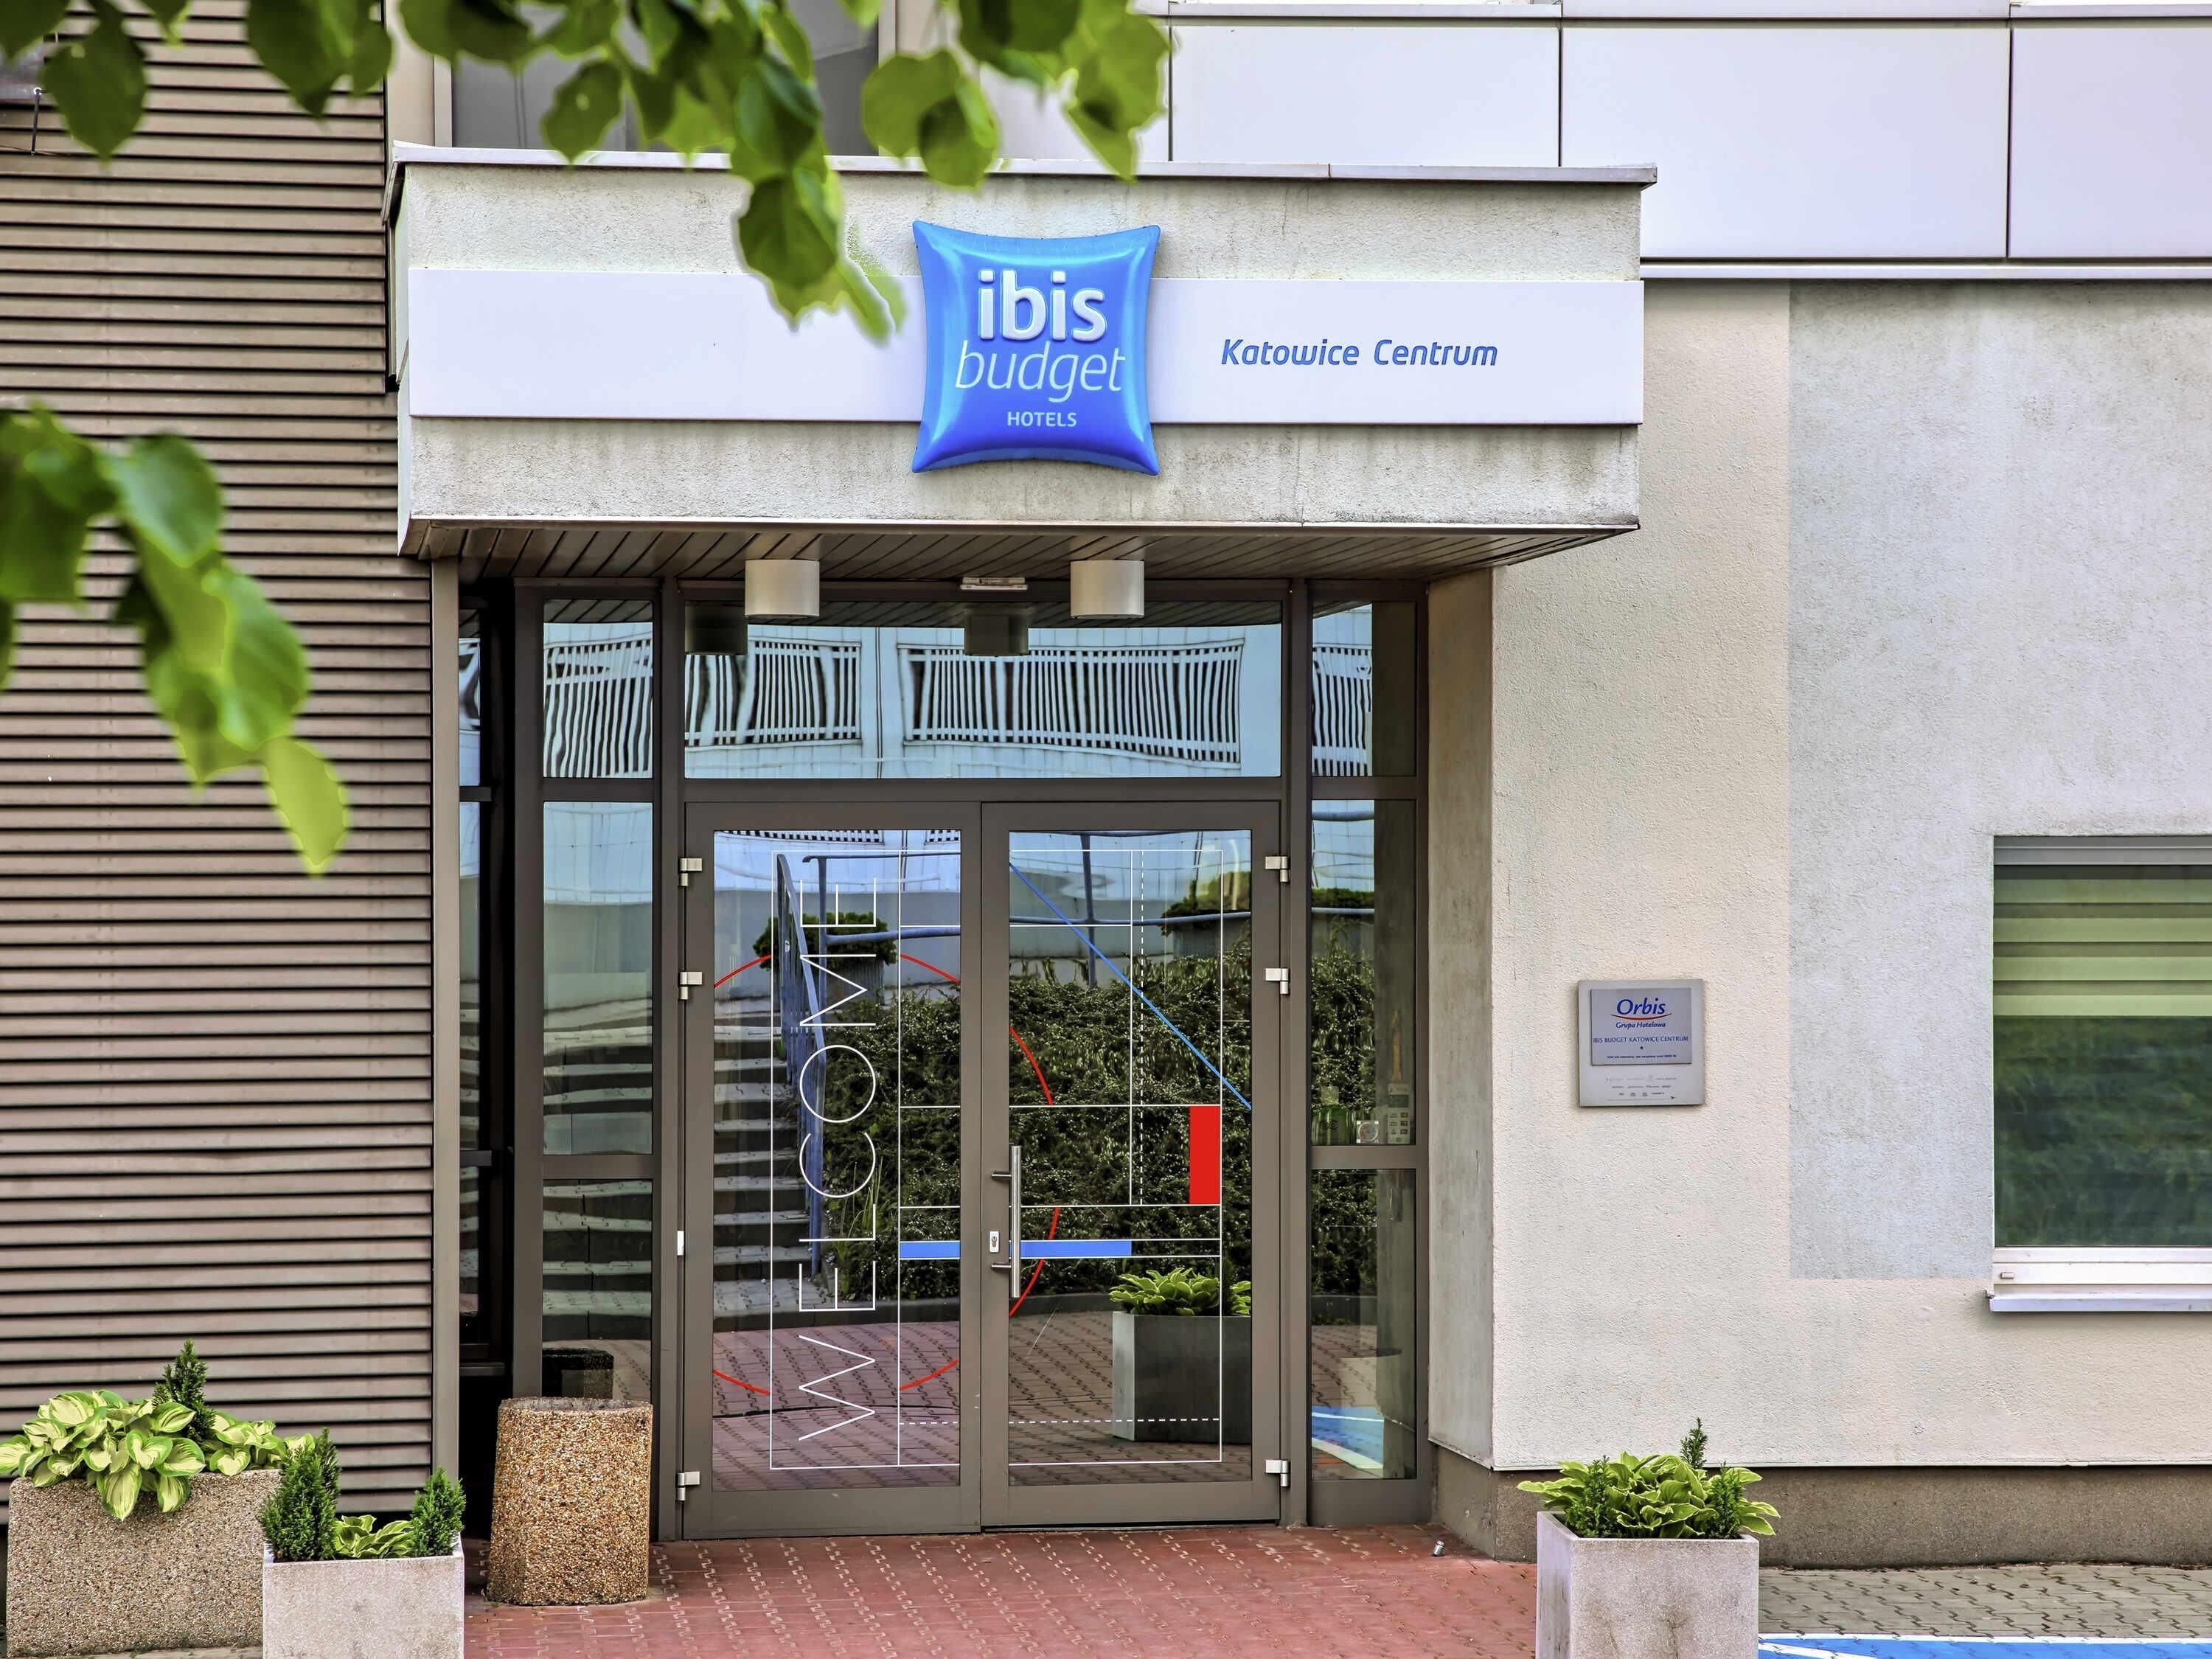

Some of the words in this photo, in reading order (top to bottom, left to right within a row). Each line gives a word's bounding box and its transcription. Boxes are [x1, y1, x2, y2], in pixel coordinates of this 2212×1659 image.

[977, 268, 1107, 342] ibis
[955, 340, 1126, 403] budget
[1221, 338, 1360, 366] Katowice
[1374, 338, 1499, 366] Centrum
[1006, 411, 1077, 428] HOTELS
[1616, 998, 1666, 1015] Orbis
[799, 877, 876, 1441] WELCOME
